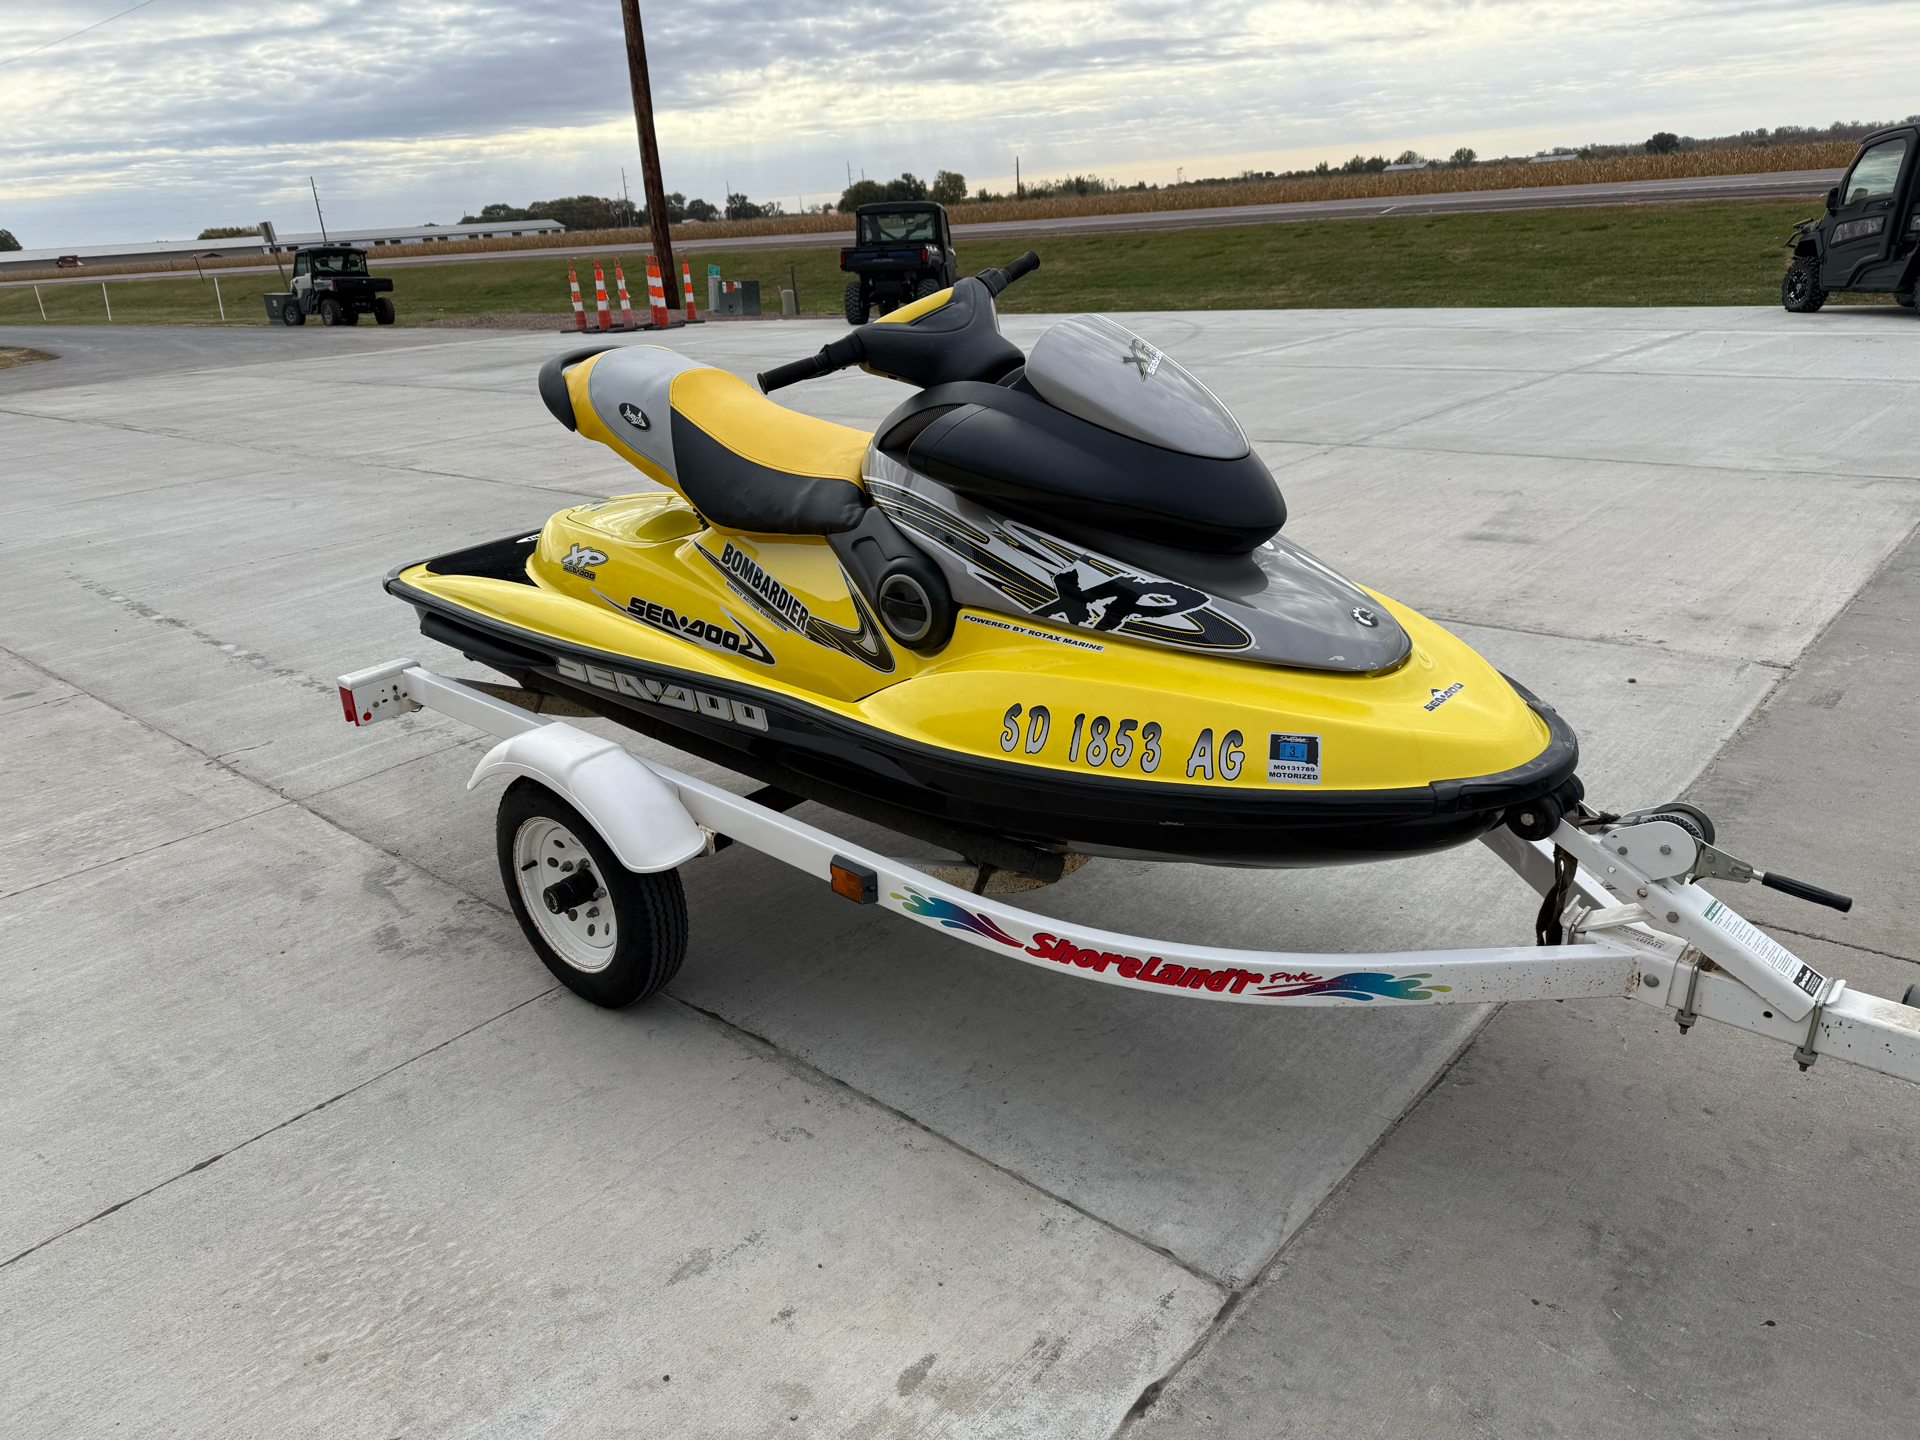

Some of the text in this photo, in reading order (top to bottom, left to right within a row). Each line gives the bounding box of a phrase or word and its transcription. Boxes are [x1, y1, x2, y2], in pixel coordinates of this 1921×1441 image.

[561, 543, 609, 568] XP
[720, 541, 809, 632] BOMBARDIER
[725, 580, 788, 632] DIRECT ACTION SUSPENSION
[963, 614, 1104, 652] POWERED BY ROTAX MARINE
[1000, 702, 1245, 781] SD 1853 AG
[1289, 745, 1296, 757] 3
[1268, 771, 1319, 781] MOTORIZED
[1273, 764, 1315, 773] MO131789
[1269, 971, 1323, 984] PWC
